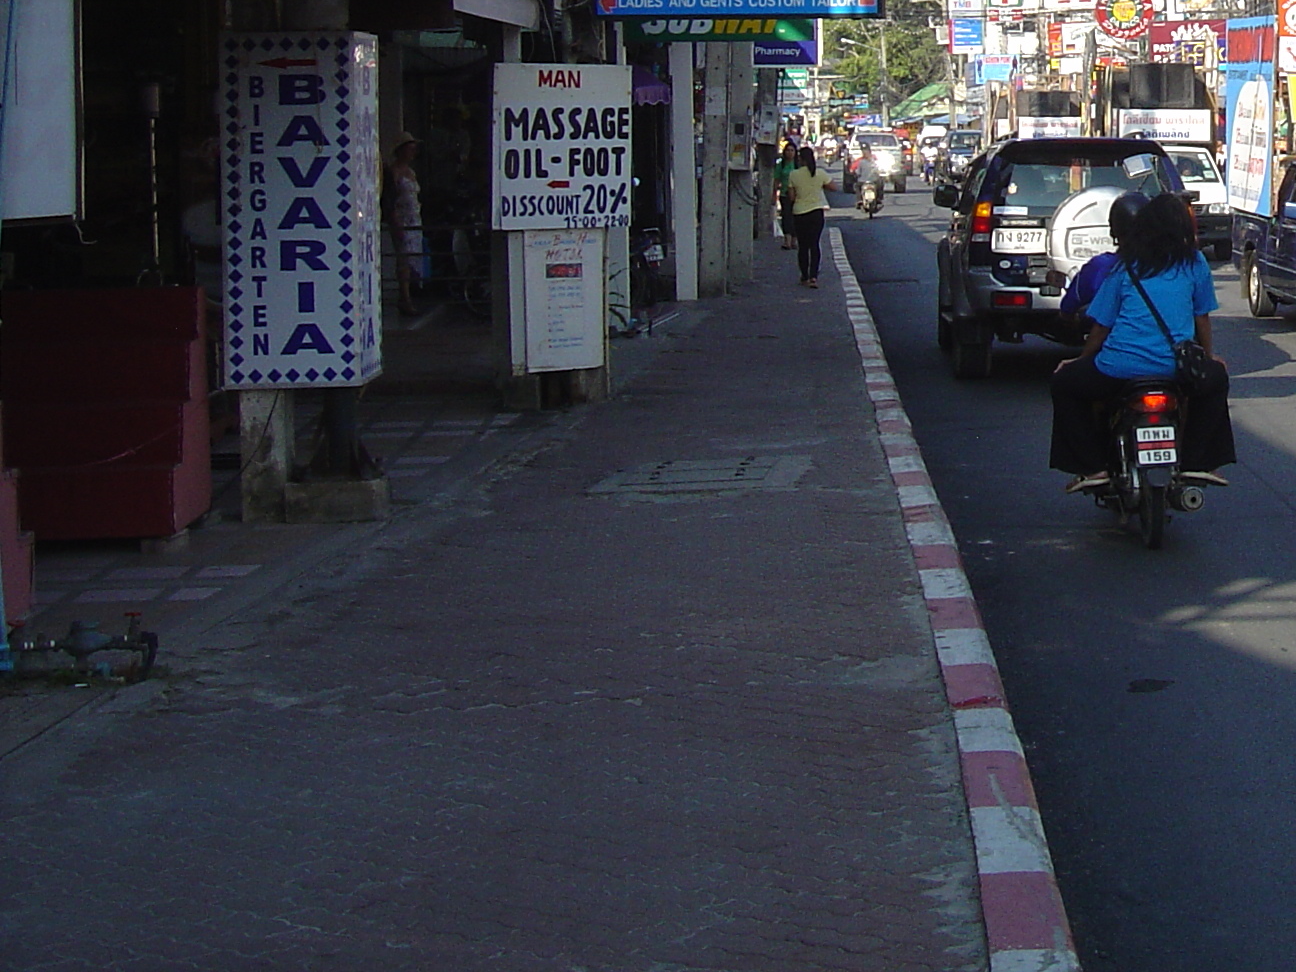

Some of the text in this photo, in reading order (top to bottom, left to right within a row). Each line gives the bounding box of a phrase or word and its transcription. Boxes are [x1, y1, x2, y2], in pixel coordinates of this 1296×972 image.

[755, 45, 801, 57] Pharmacy
[538, 70, 581, 88] MAN
[504, 107, 629, 142] MASSAGE
[501, 182, 628, 217] DISSCOUNT 20%
[249, 75, 270, 357] BIERGARTEN
[276, 74, 336, 356] BAVARIA
[1017, 231, 1043, 243] 9277
[1146, 450, 1171, 462] 159
